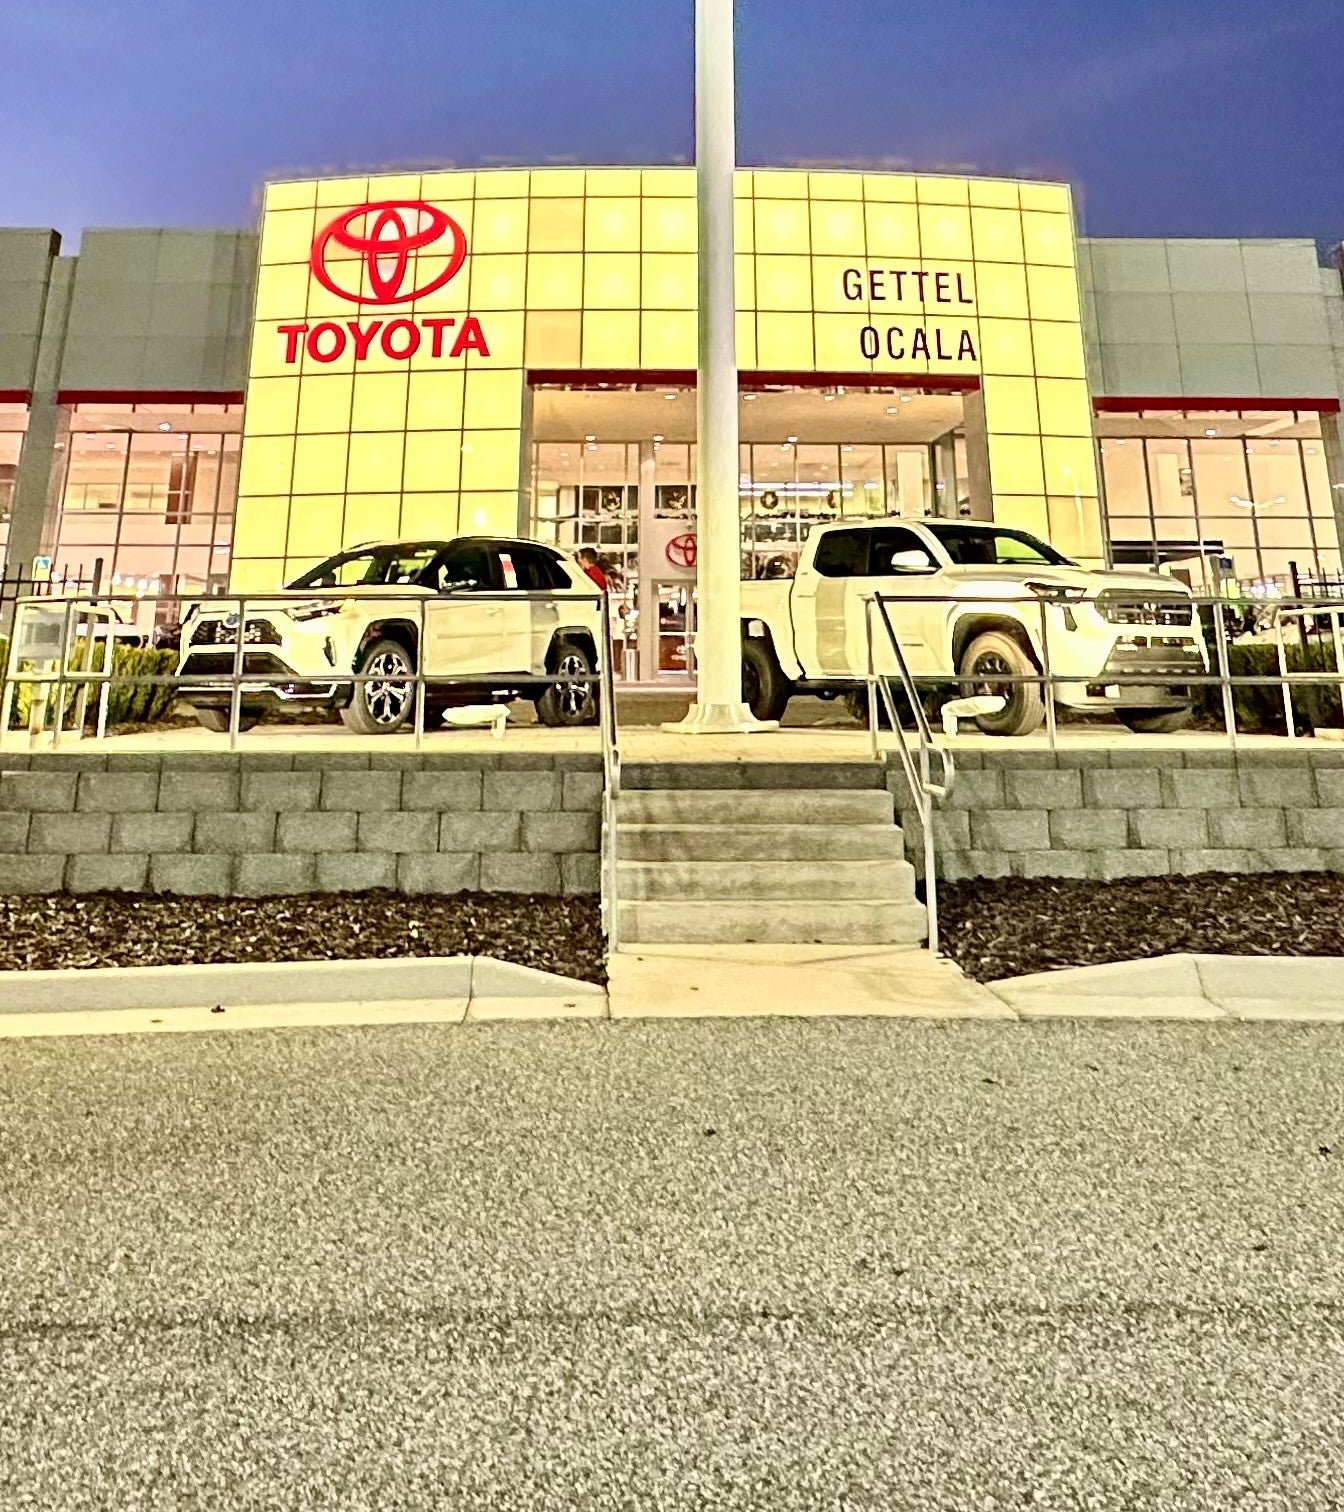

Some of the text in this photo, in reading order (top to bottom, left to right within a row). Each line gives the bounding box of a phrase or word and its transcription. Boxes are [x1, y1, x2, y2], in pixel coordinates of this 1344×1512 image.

[843, 269, 973, 304] GETTEL
[277, 317, 491, 364] TOYOTA
[860, 326, 977, 361] OCALA
